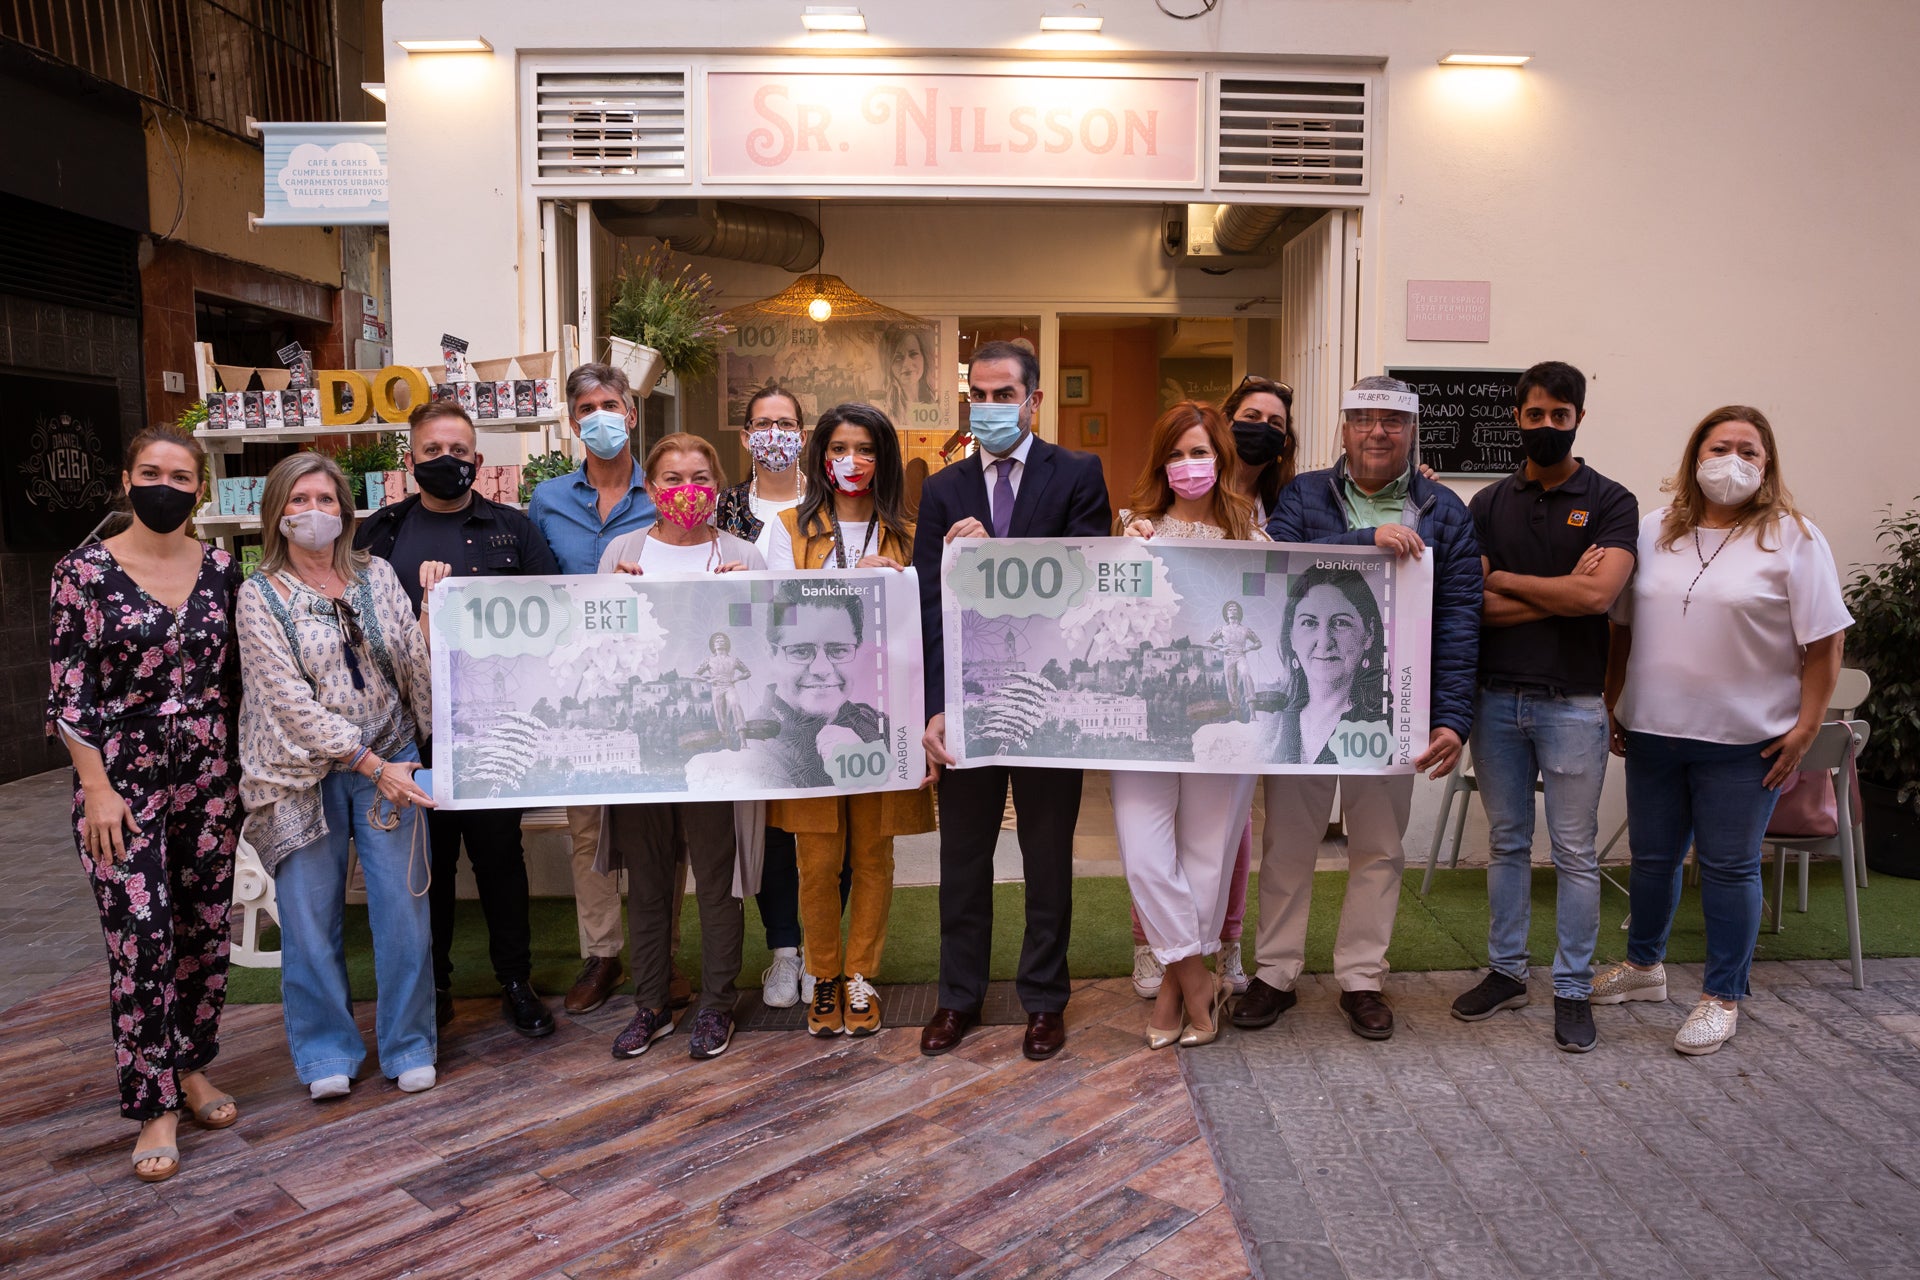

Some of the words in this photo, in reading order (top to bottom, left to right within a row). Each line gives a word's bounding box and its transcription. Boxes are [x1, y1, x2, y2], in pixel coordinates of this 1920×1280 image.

[307, 158, 328, 167] CAFÉ
[331, 159, 338, 167] &
[341, 159, 367, 167] CAKES
[285, 178, 348, 186] CAMPAMENTOS
[292, 169, 331, 177] CUMPLES
[333, 169, 383, 177] DIFERENTES
[293, 188, 334, 196] TALLERES
[337, 188, 382, 196] CREATIVOS
[737, 326, 776, 348] 100
[172, 375, 178, 389] 7
[1407, 383, 1442, 397] DEJA
[1447, 382, 1464, 396] UN
[912, 408, 939, 422] 100
[1418, 403, 1465, 418] PAGADO
[52, 432, 82, 450] DANIEL
[47, 448, 90, 485] VEIGA
[976, 556, 1063, 600] 100
[464, 595, 550, 639] 100
[1400, 666, 1412, 714] PRENSA
[1400, 716, 1411, 733] DE
[897, 726, 908, 780] ARABOKA
[1338, 731, 1388, 758] 100
[1399, 735, 1411, 765] PASE
[834, 751, 886, 779] 100
